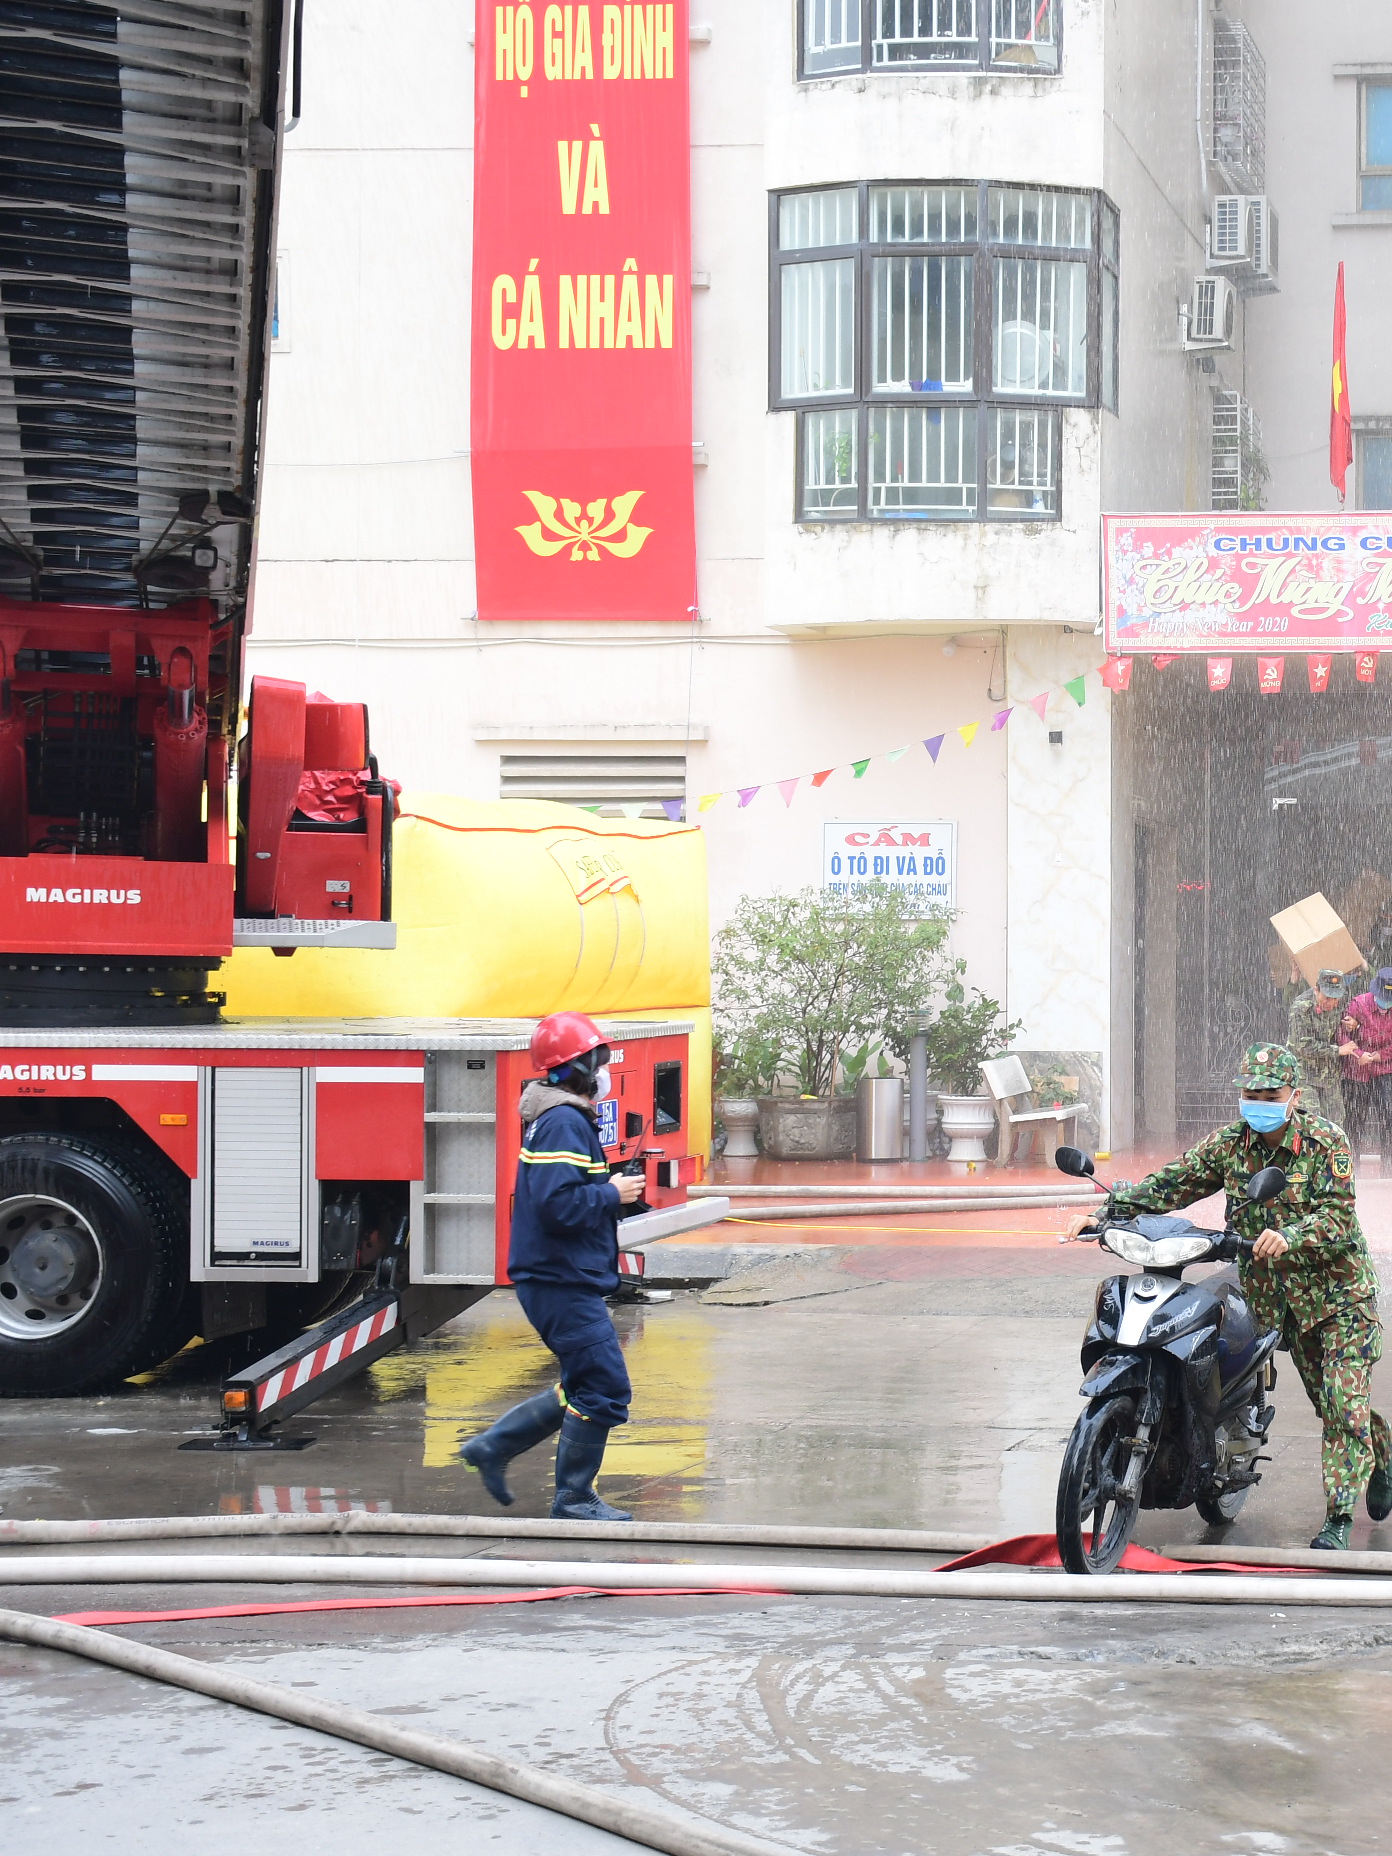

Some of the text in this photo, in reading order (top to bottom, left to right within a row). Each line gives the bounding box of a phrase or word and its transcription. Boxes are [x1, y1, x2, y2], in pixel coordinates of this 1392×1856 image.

[543, 4, 594, 81] GIA
[558, 124, 610, 215] VÀ
[492, 257, 674, 350] CÁ NHÂN
[1213, 536, 1346, 551] CHUNG
[1133, 557, 1243, 613] Chúc
[1224, 556, 1354, 622] Mừng
[1147, 616, 1289, 637] Happy New Year 2020
[844, 825, 932, 847] CẤM
[831, 848, 946, 876] Ô TÔ ĐI VÀ ĐỖ
[25, 887, 142, 904] MAGIRUS
[0, 1065, 87, 1081] AGIRUS
